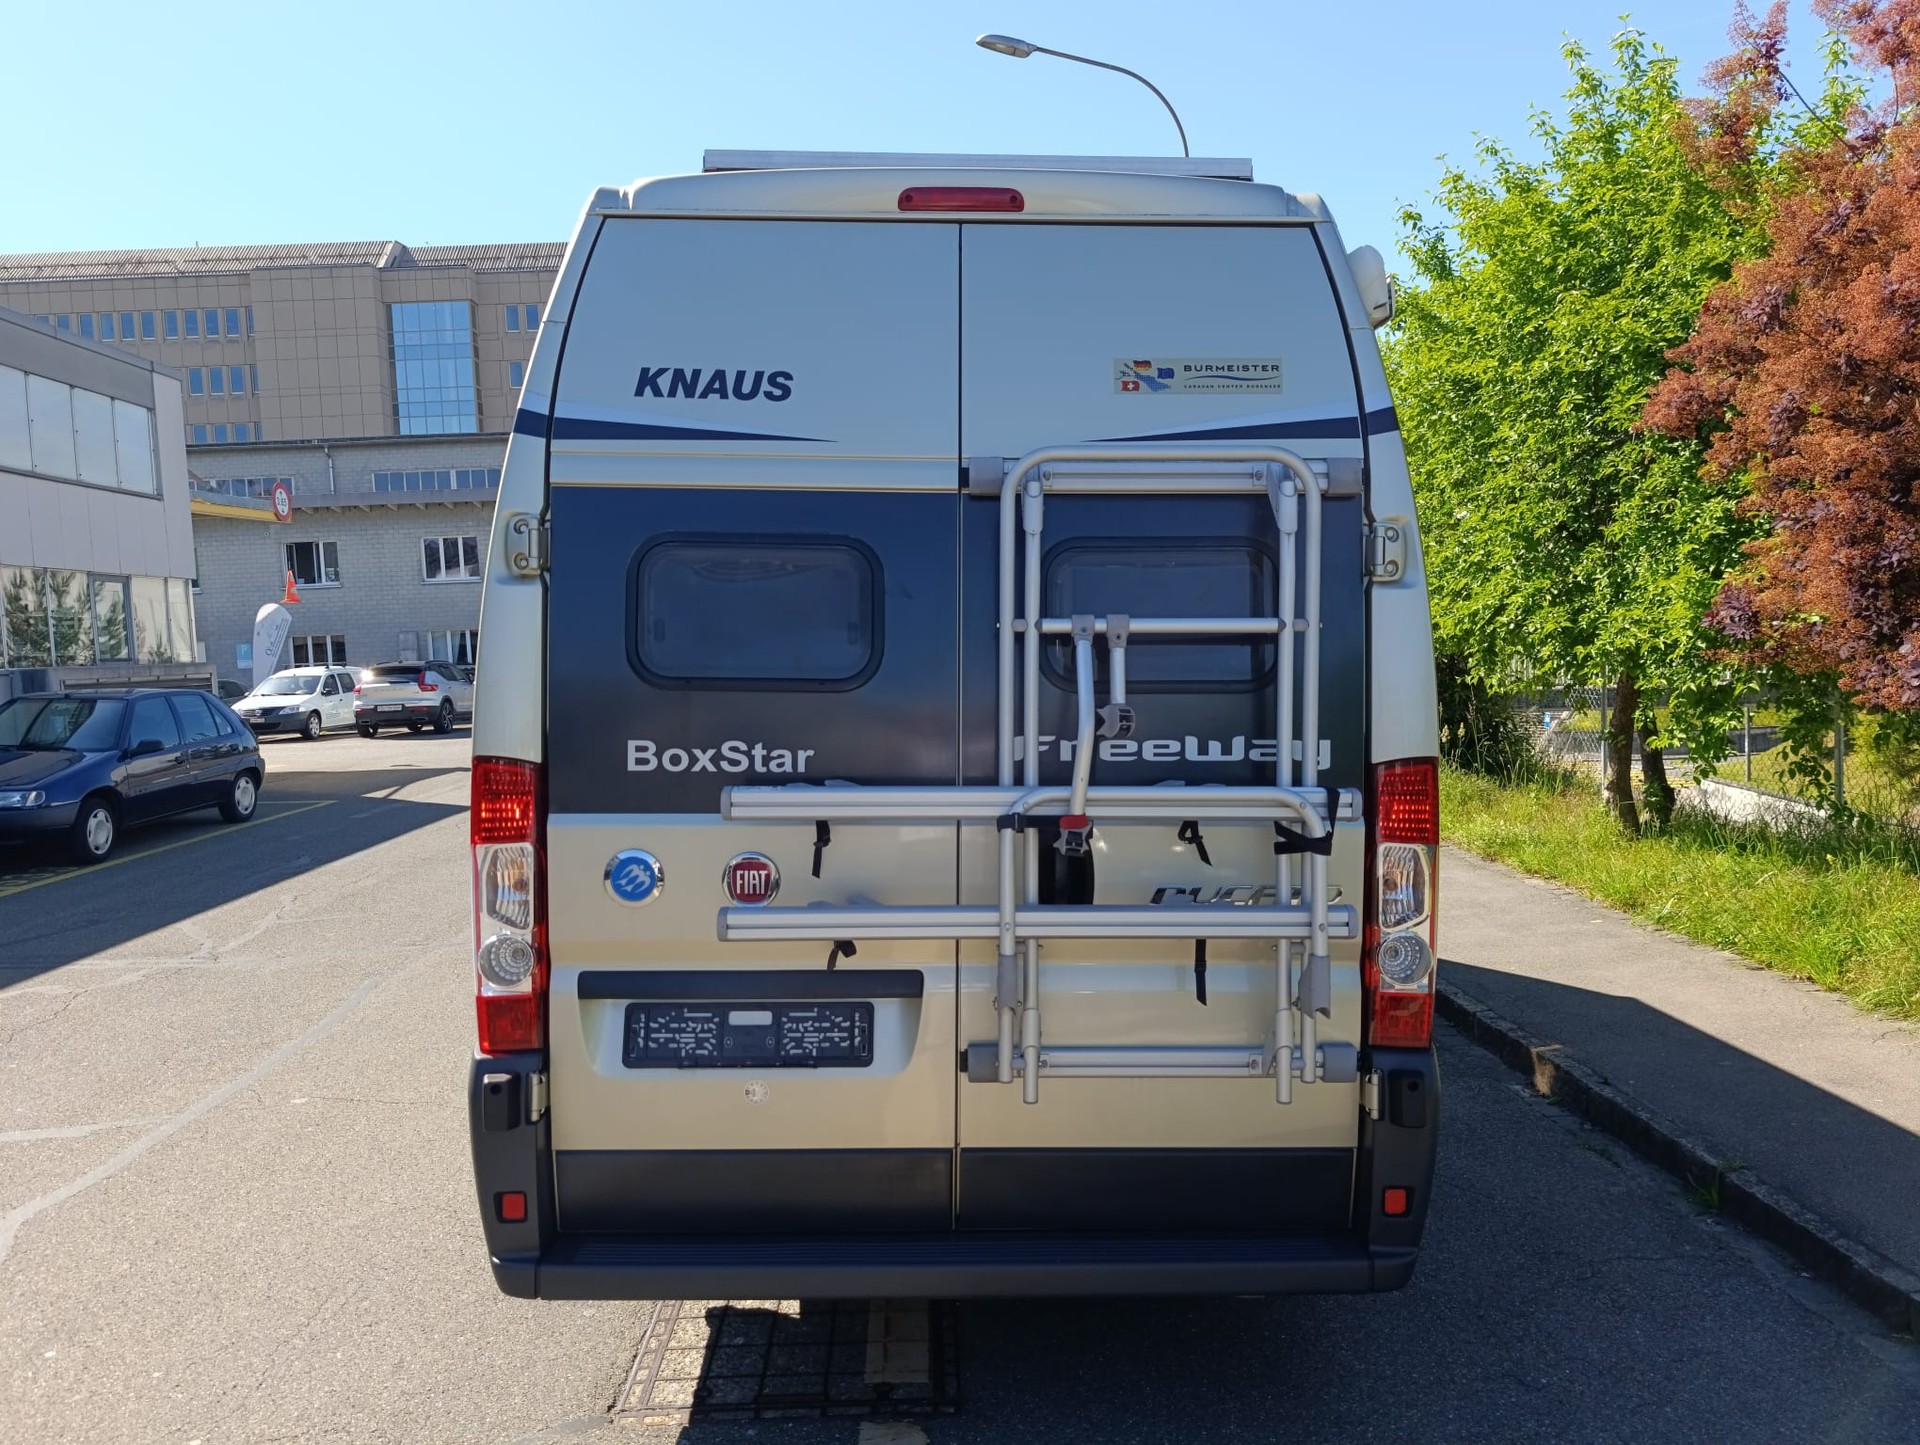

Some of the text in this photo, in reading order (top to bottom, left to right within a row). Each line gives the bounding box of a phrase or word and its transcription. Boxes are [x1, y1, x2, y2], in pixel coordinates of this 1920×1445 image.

[1183, 364, 1280, 372] BURMEISTER
[634, 367, 794, 402] KNAUS
[627, 739, 815, 773] BoxStar
[736, 870, 768, 895] FIAT
